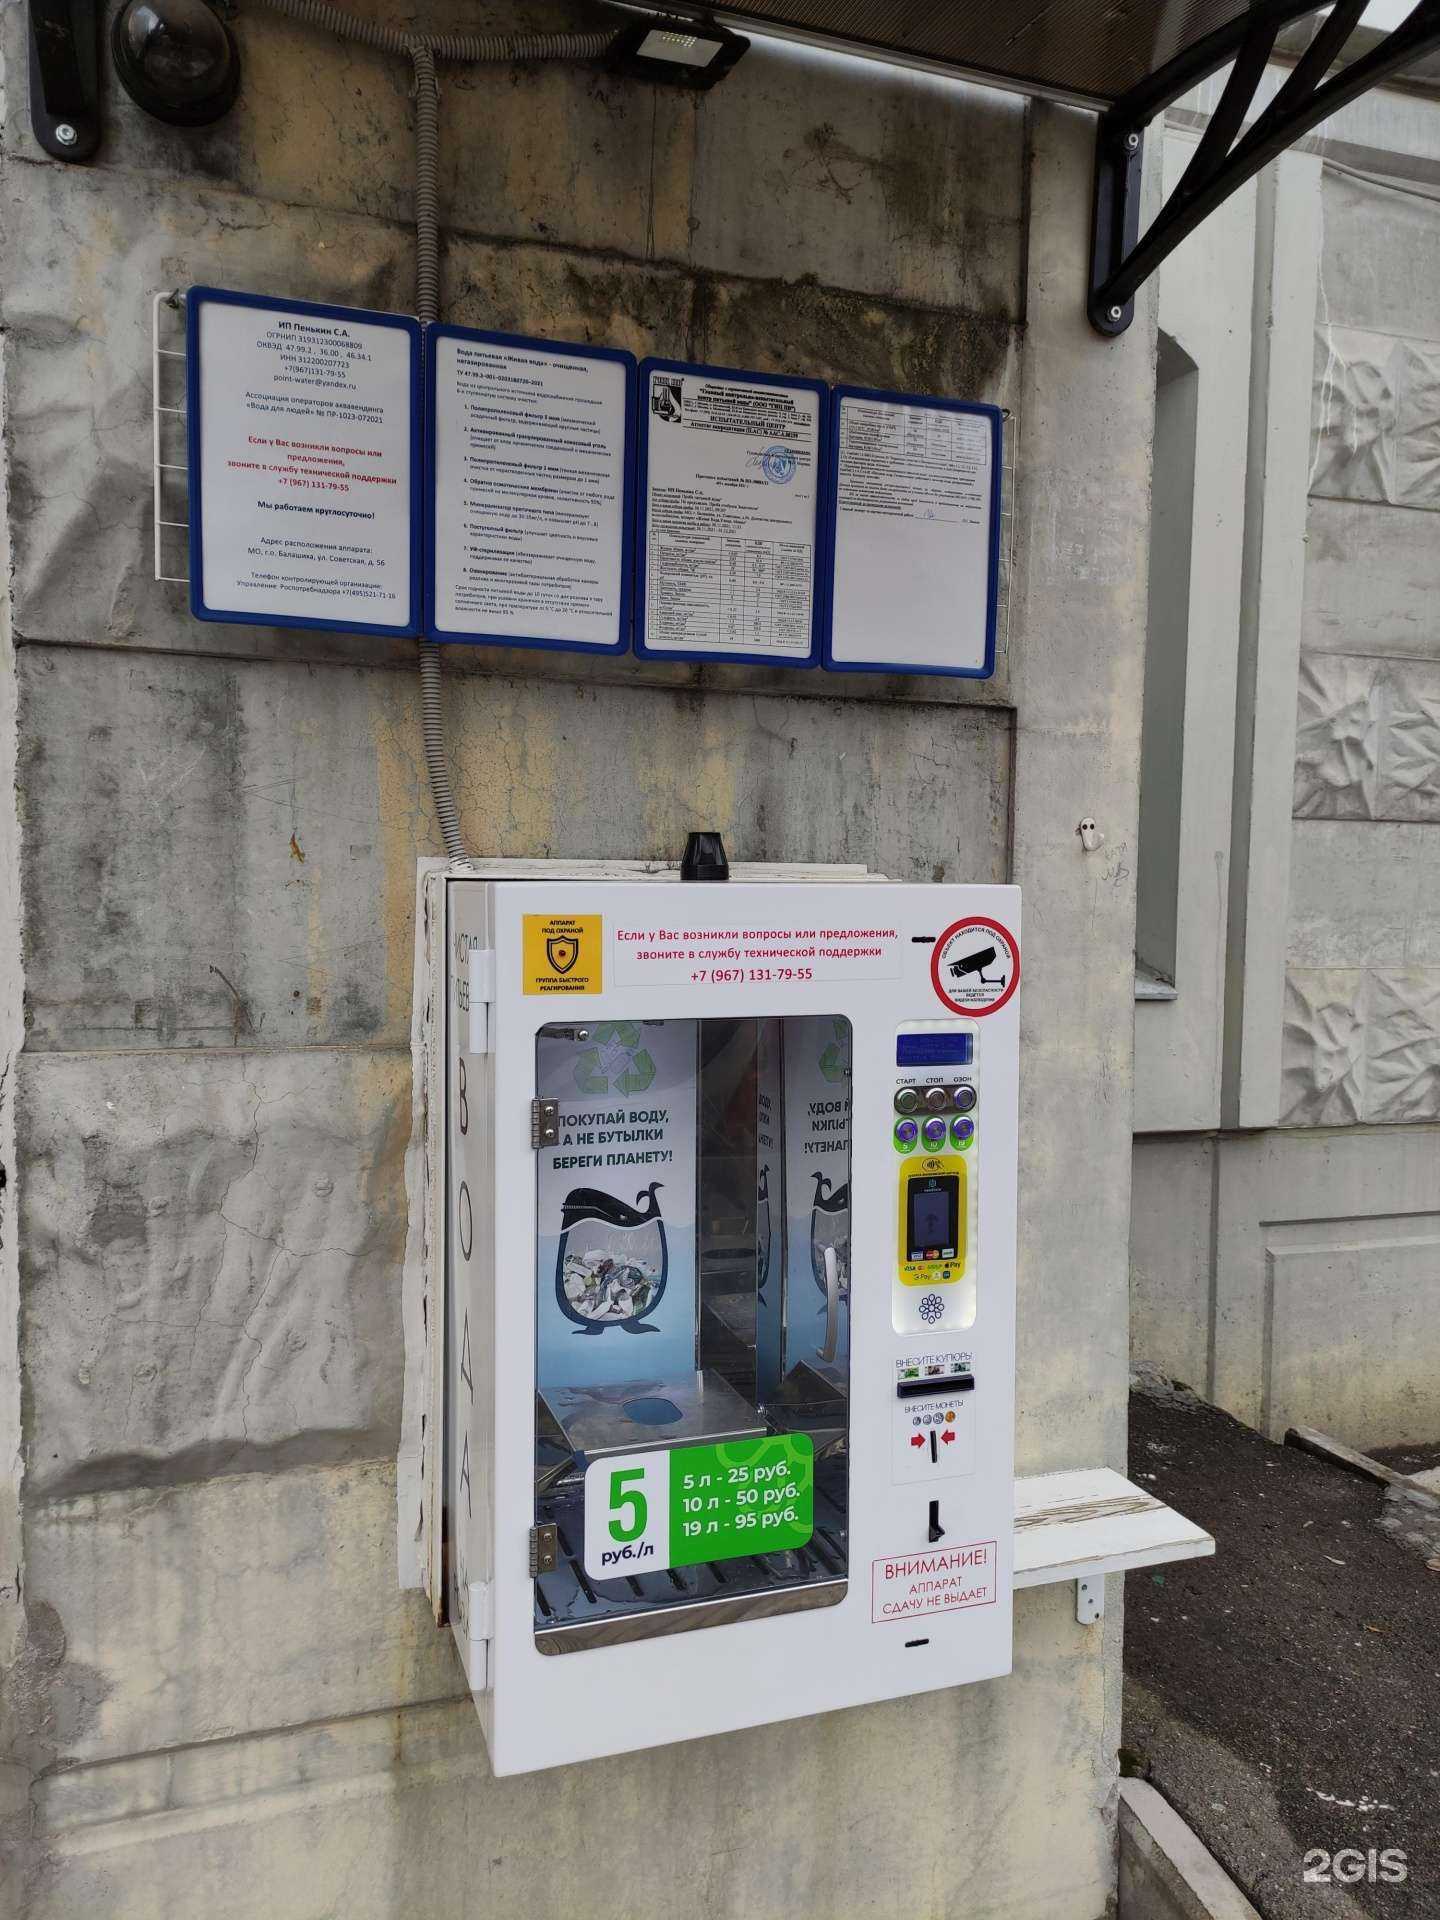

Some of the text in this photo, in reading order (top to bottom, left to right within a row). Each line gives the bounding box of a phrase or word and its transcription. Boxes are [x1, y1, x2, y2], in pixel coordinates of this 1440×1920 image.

[267, 331, 297, 341] ОГРНИП
[279, 321, 350, 338] ИП Пенькин С.А.
[280, 354, 297, 362] ИНН
[246, 392, 289, 402] Ассоциация
[291, 398, 334, 407] операторов
[270, 404, 284, 412] для
[249, 436, 267, 445] Если
[276, 439, 290, 447] Вас
[292, 442, 329, 451] возникли
[331, 446, 365, 456] вопросы
[287, 454, 345, 466] предложения,
[228, 460, 260, 470] звоните
[268, 465, 298, 475] службу
[301, 468, 350, 479] технической
[352, 474, 397, 485] поддержки
[290, 479, 310, 488] (967)
[312, 481, 349, 492] 131-79-55
[258, 500, 375, 520] Мы работаем круглосуточно!
[261, 537, 282, 546] Адрес
[285, 540, 337, 551] расположения
[252, 572, 280, 581] Телефон
[617, 929, 898, 942] Если у Вас возникли вопросы или предложения,
[942, 928, 1011, 959] ОБЪЕКТ НАХОДИТСЯ ПОД ОХРАНОЙ
[636, 947, 882, 962] звоните в службу технической поддержки
[691, 968, 812, 983] +7 (967) 131-79-55
[558, 1109, 669, 1127] ПОКУПАЙ ВОДУ,
[563, 1129, 664, 1146] А НЕ БУТЫЛКИ
[553, 1150, 673, 1169] БЕРЕГИ ПЛАНЕТУ!
[683, 1474, 694, 1490] 5
[699, 1475, 711, 1488] л
[728, 1467, 749, 1483] 25
[754, 1460, 791, 1483] руб.
[608, 1468, 648, 1543] 5
[682, 1498, 703, 1513] 10
[707, 1497, 719, 1510] л
[736, 1488, 758, 1506] 50
[763, 1482, 800, 1504] руб.
[682, 1521, 702, 1536] 19
[706, 1521, 718, 1534] л
[735, 1512, 757, 1529] 95
[762, 1506, 799, 1528] руб.
[601, 1542, 654, 1566] руб./л
[885, 1549, 987, 1580] ВНИМАНИЕ!
[909, 1577, 962, 1595] АППАРАТ
[883, 1587, 988, 1614] СДАЧУ НЕ ВЫДАЕТ
